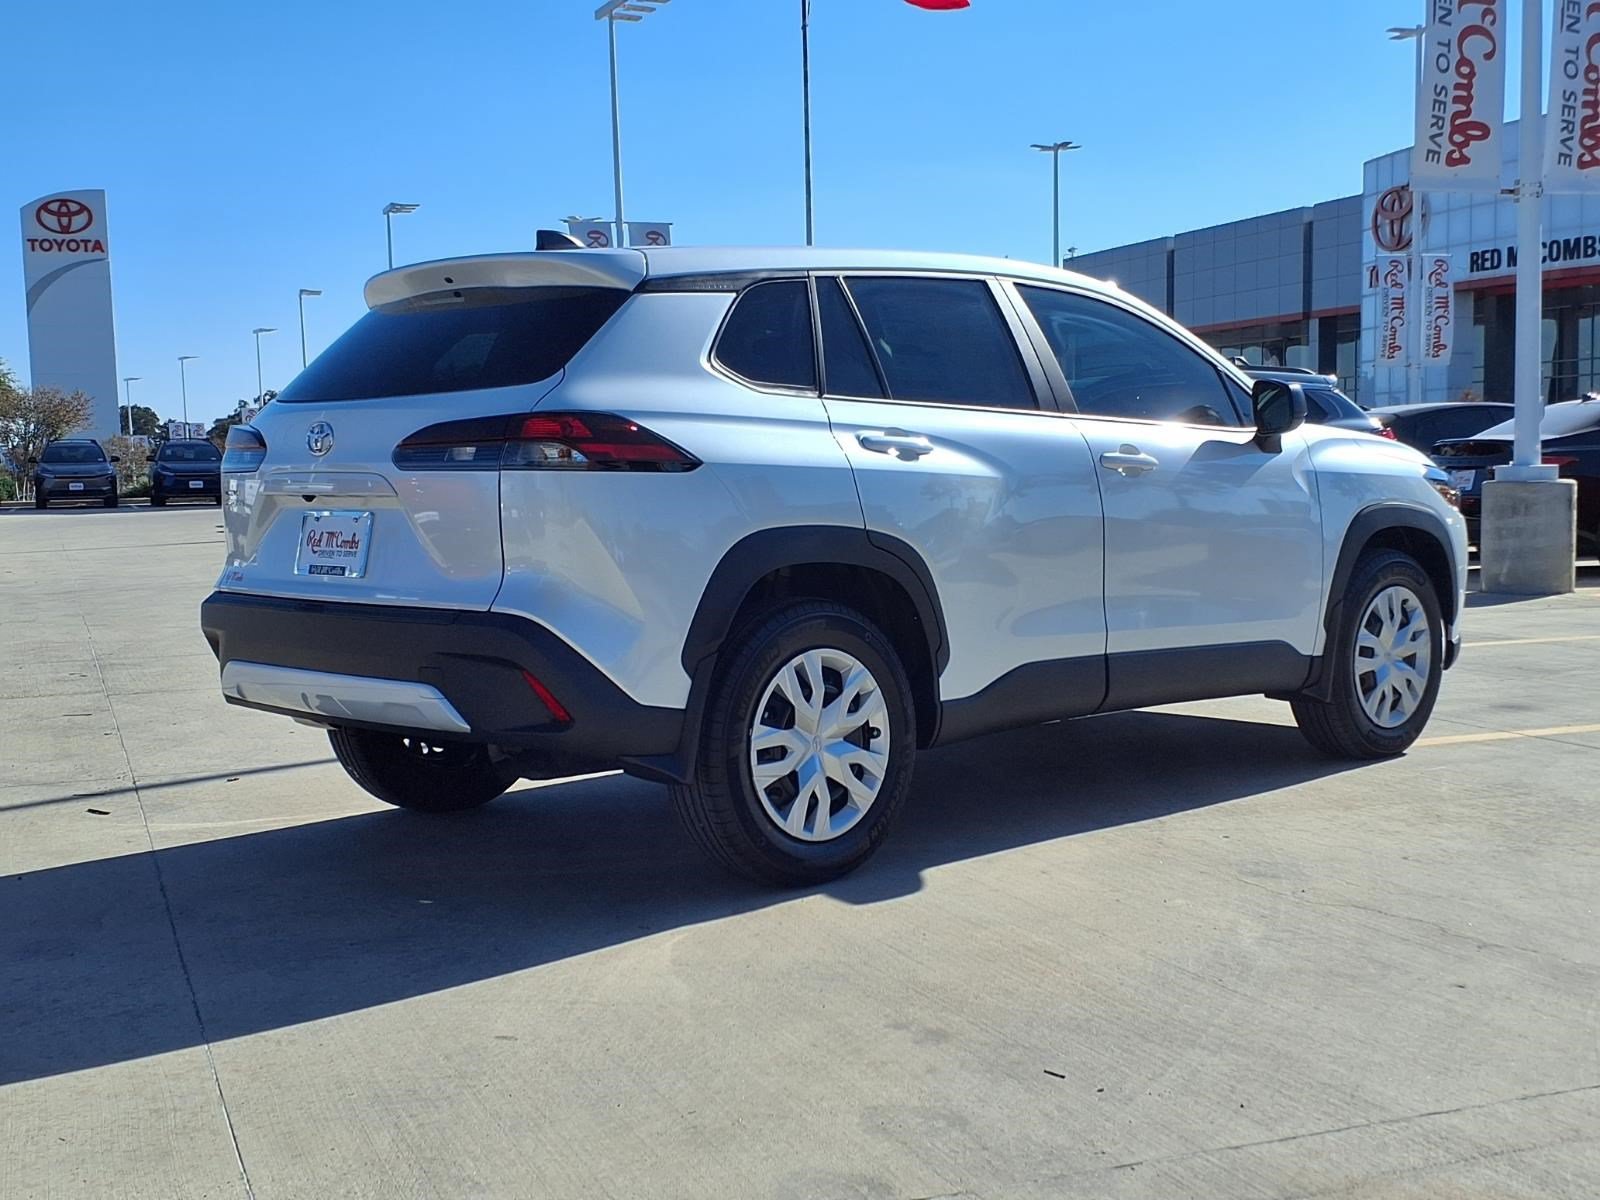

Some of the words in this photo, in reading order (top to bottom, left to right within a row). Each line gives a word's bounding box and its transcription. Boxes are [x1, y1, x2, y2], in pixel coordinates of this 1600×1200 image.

[1435, 39, 1451, 74] TO
[1563, 46, 1580, 80] TO
[1445, 0, 1497, 168] cCombs
[1425, 84, 1448, 165] SERVE
[1557, 89, 1578, 167] SERVE
[27, 238, 105, 254] TOYOTA
[1469, 248, 1502, 273] RED
[1384, 259, 1404, 289] Red
[1428, 259, 1449, 288] Red
[1387, 292, 1406, 360] McCombs
[1431, 291, 1451, 359] McCombs
[306, 529, 324, 554] Red
[325, 530, 360, 550] McCombs
